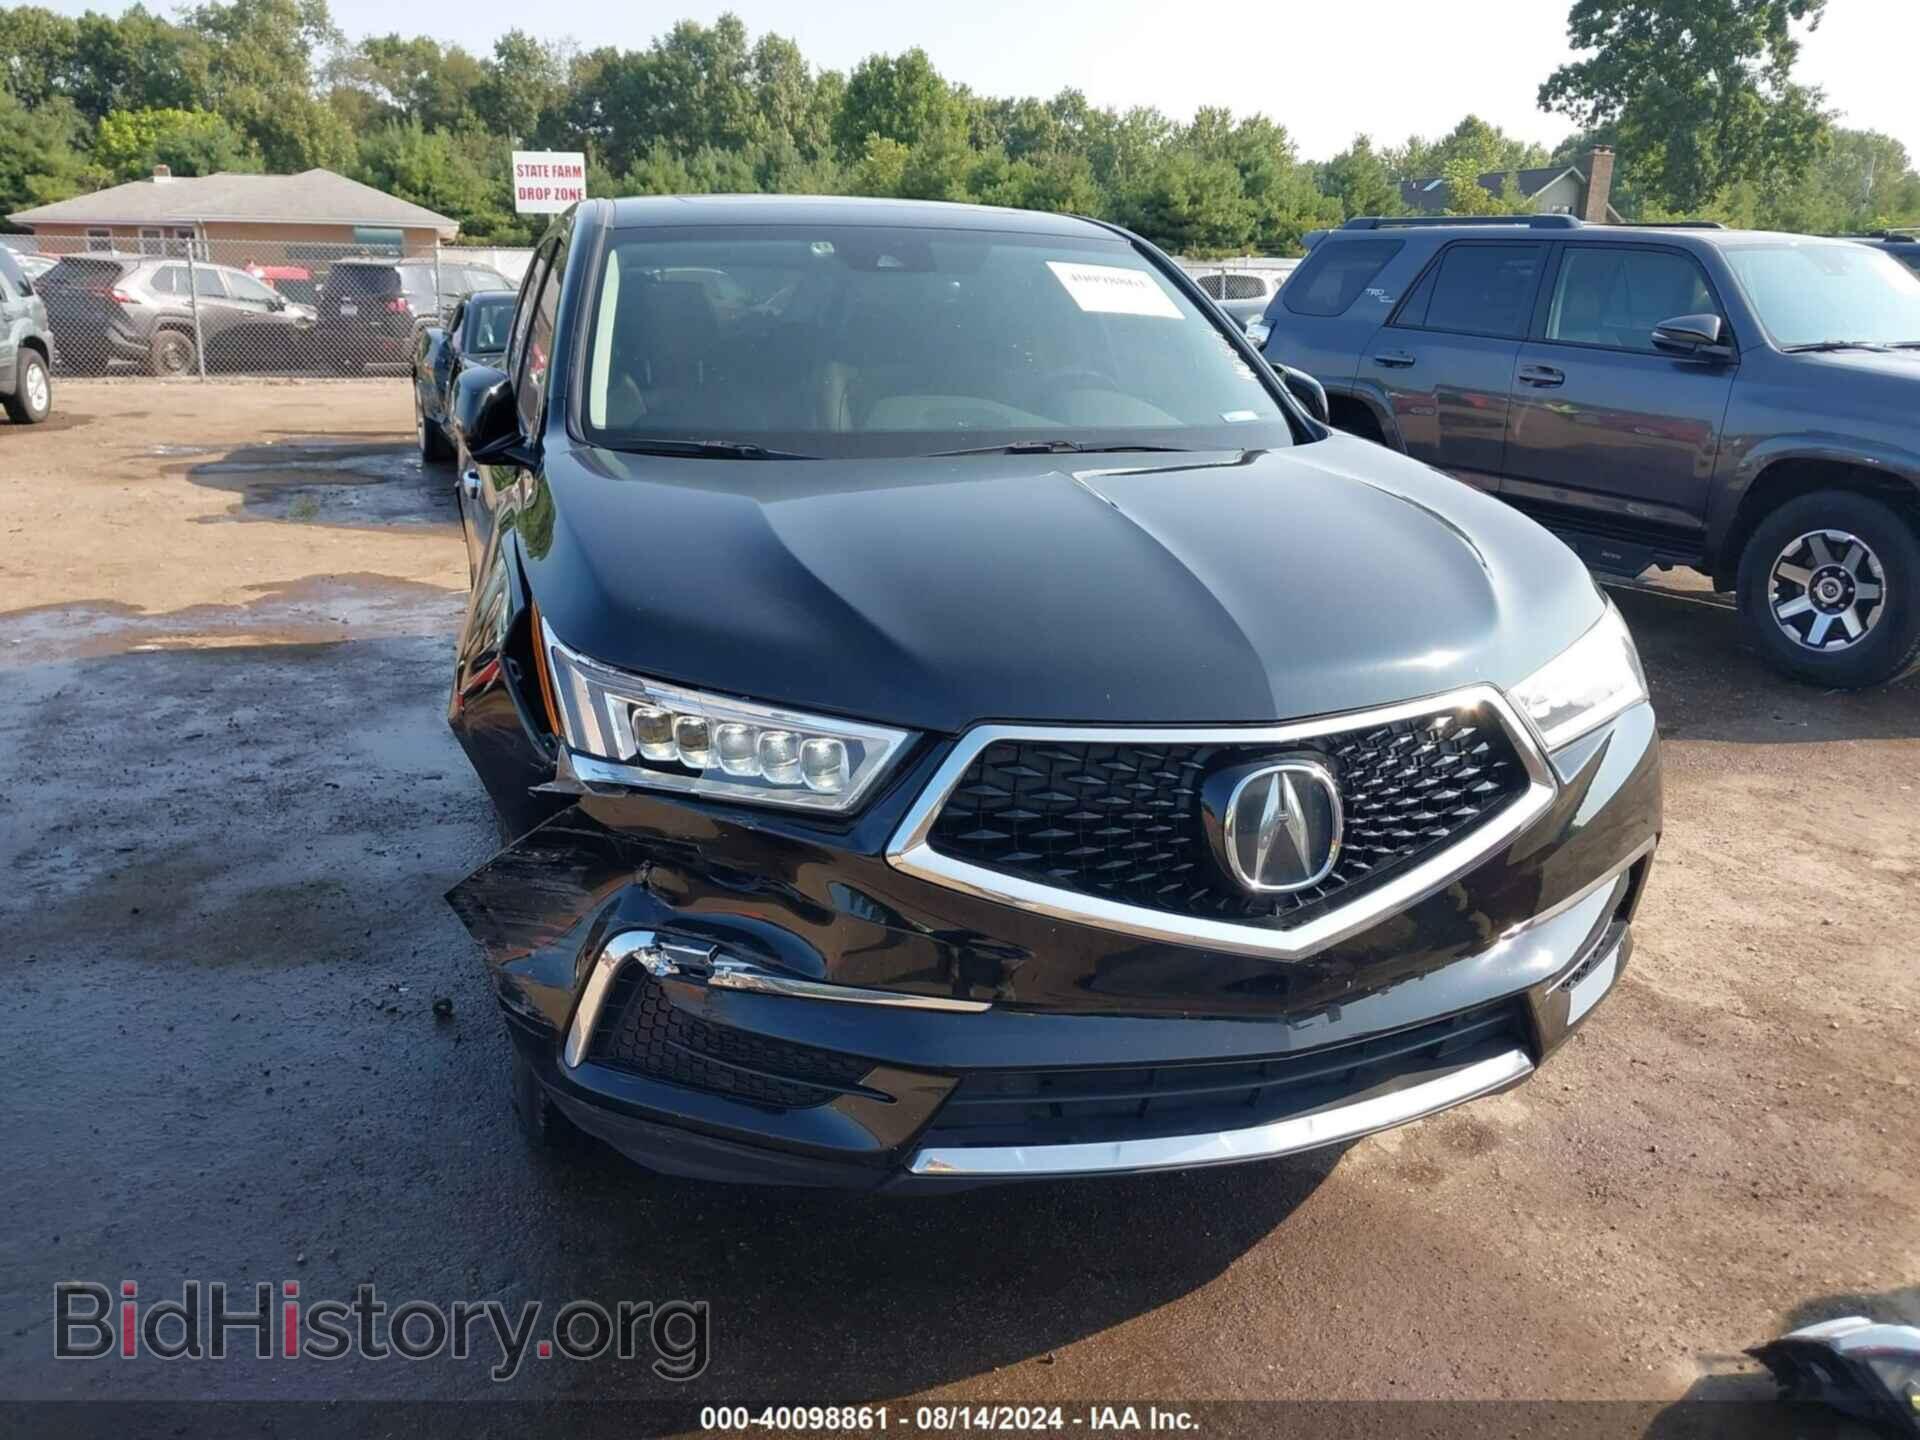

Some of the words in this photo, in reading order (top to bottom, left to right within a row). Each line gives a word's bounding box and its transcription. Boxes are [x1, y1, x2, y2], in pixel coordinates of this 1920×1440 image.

[516, 164, 549, 178] STATE
[552, 164, 582, 178] FARM
[518, 187, 551, 201] DROP
[554, 187, 583, 201] ZONE
